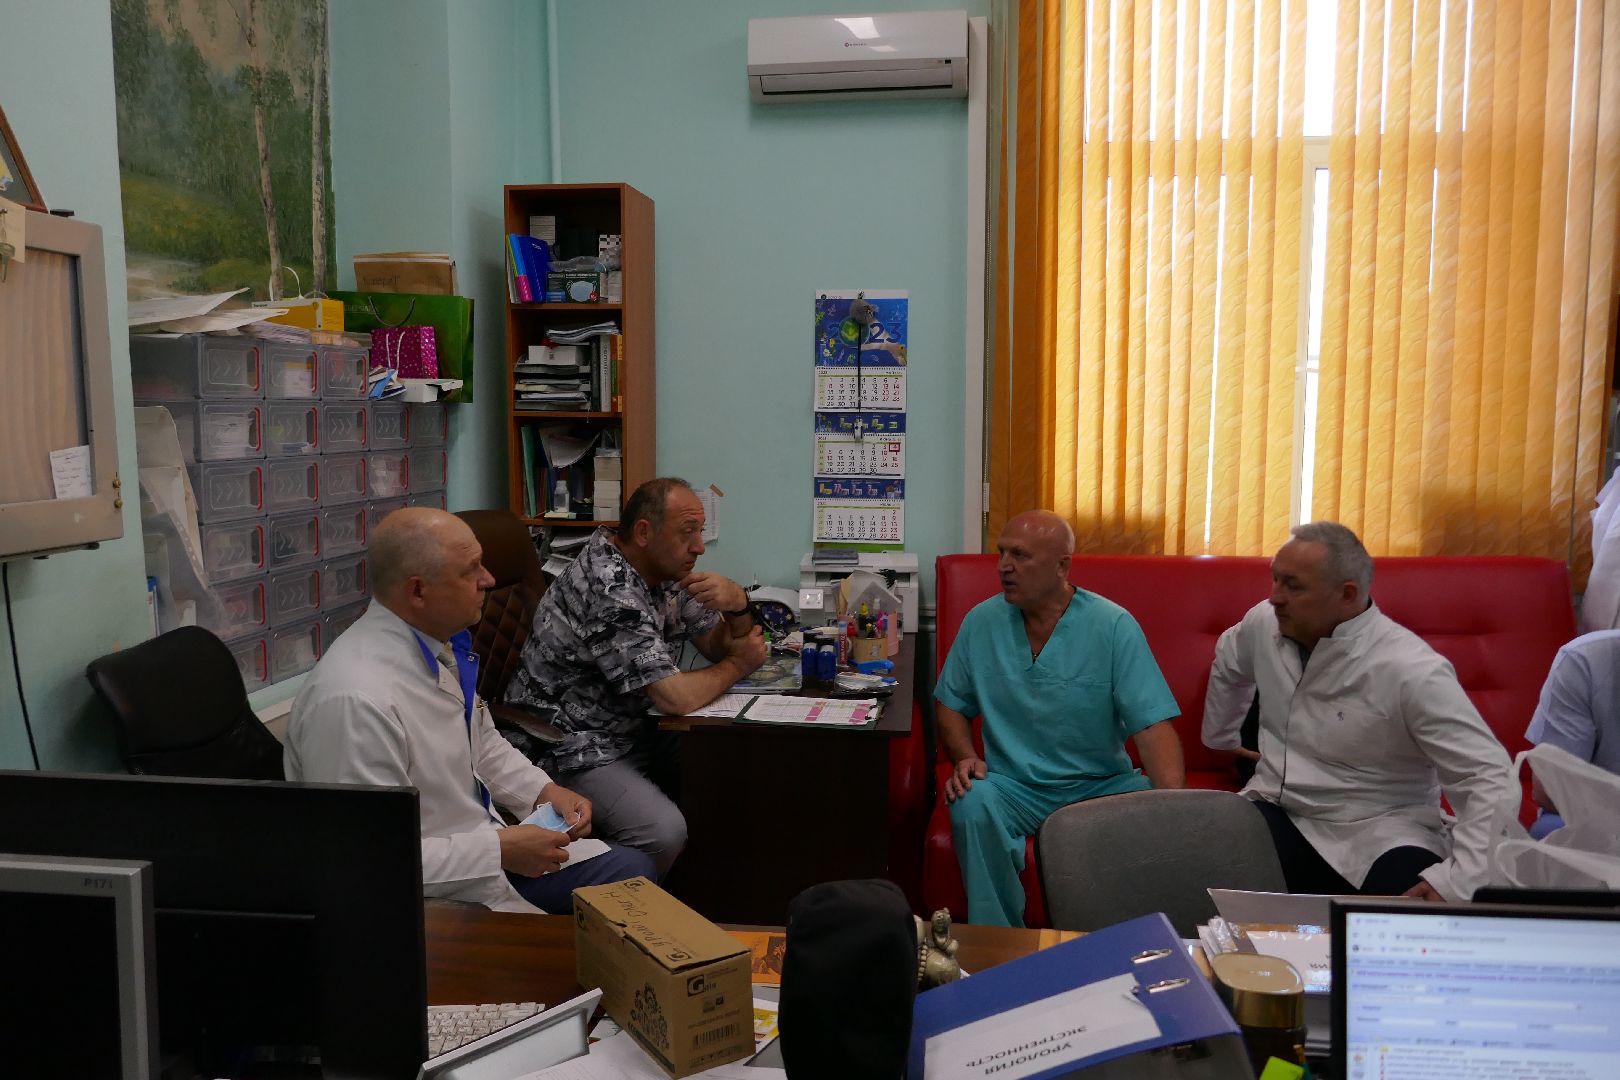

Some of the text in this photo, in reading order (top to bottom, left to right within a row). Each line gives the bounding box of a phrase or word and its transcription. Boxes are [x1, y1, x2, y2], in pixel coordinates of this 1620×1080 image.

[84, 877, 113, 889] P171
[965, 1025, 1089, 1069] ЭКСТРЕННОСТЬ
[984, 1041, 1074, 1076] УРОЛОГИЯ
